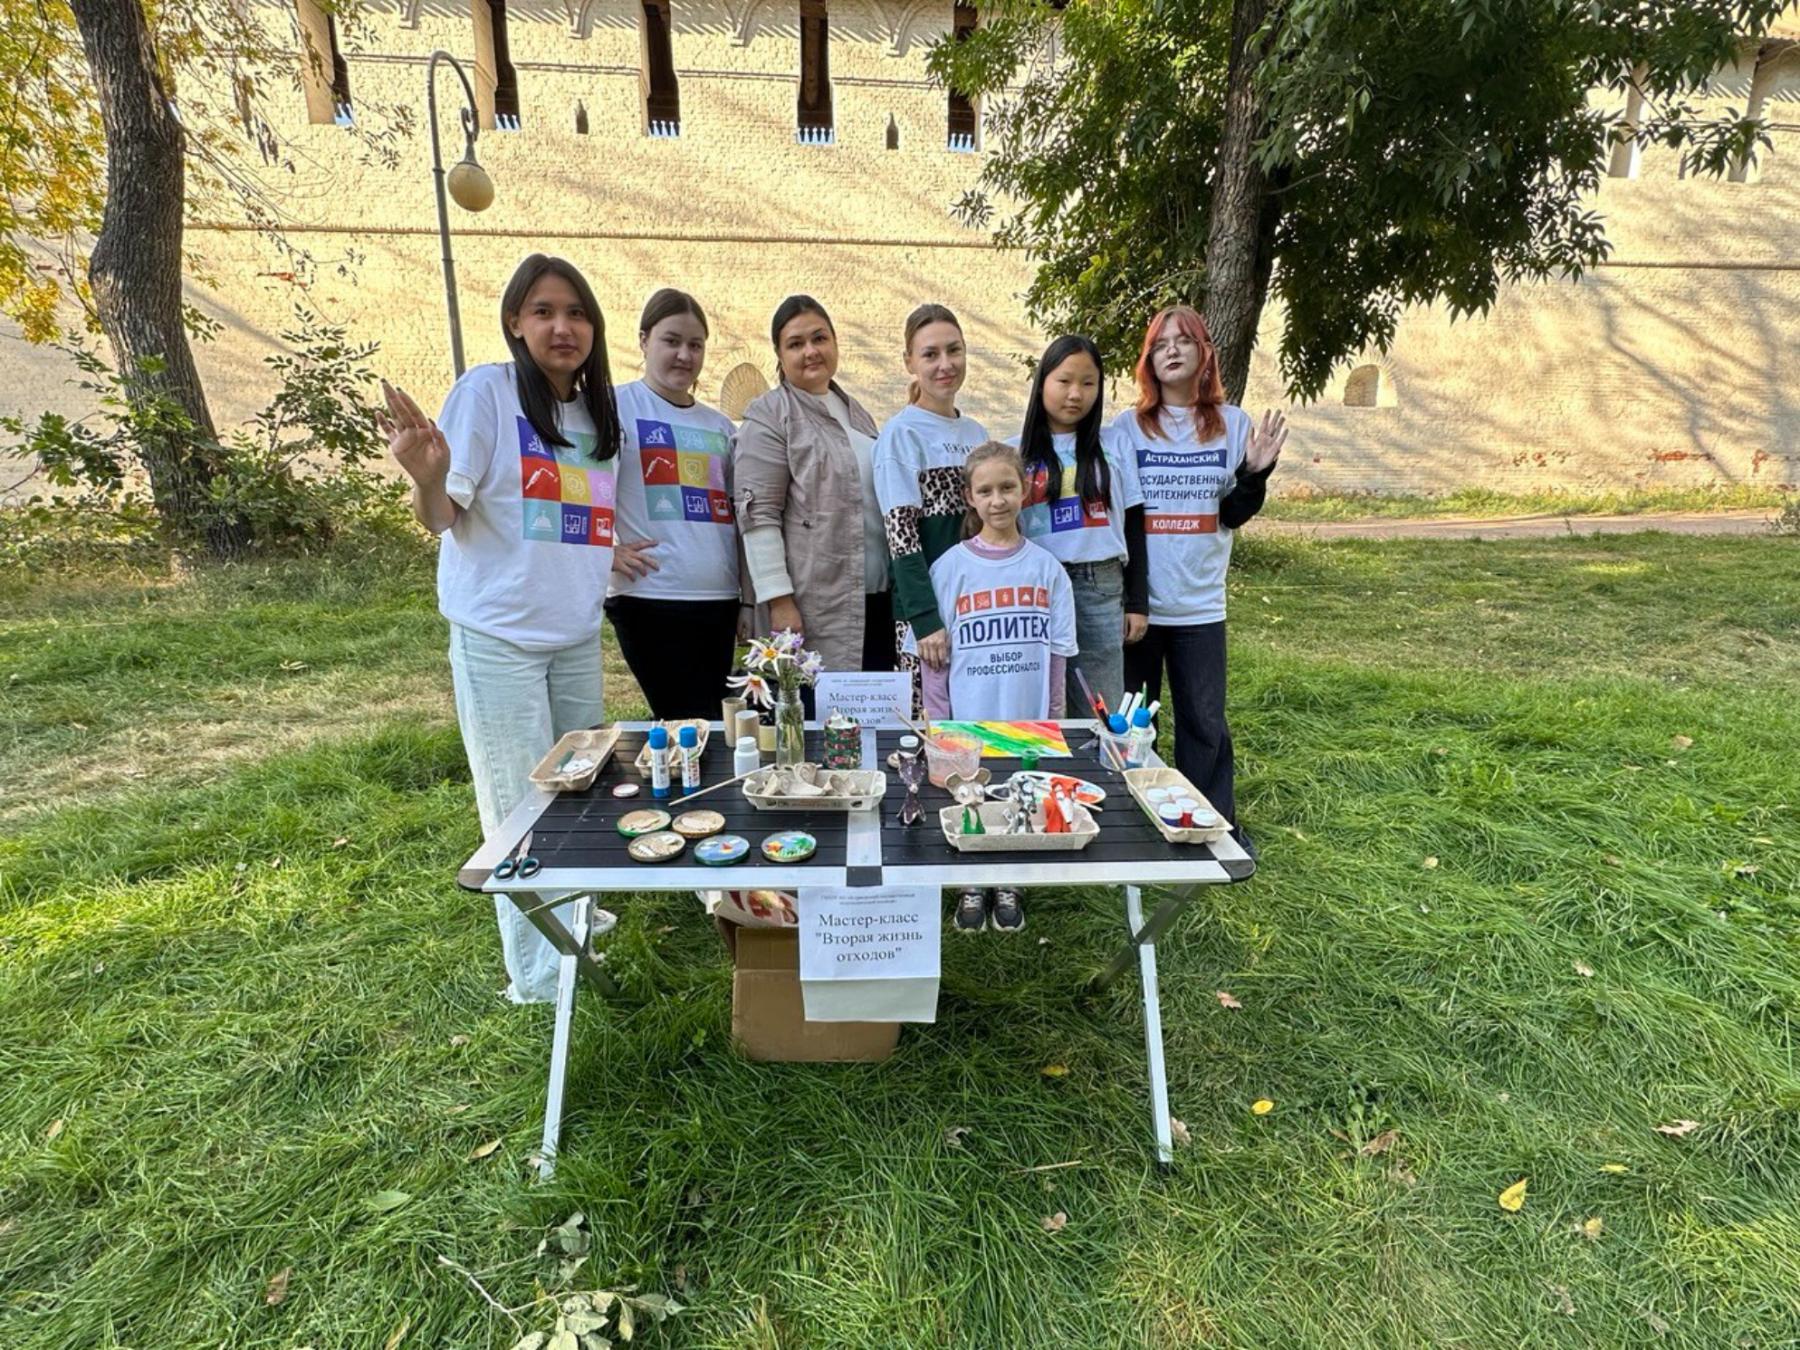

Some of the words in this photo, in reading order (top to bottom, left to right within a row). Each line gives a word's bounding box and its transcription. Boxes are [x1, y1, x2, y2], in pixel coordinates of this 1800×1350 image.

[1145, 453, 1220, 464] АСТРАХАНСКИЙ
[1152, 519, 1200, 530] КОЛЛЕДЖ
[960, 616, 1049, 645] ПОЛИТЕХ
[990, 652, 1023, 663] ВЫБОР
[829, 692, 897, 703] Мастер-класс
[819, 913, 919, 928] Мастер-класс
[816, 931, 873, 947] "Вторая
[878, 931, 923, 942] жизнь
[836, 947, 902, 962] отходов"
